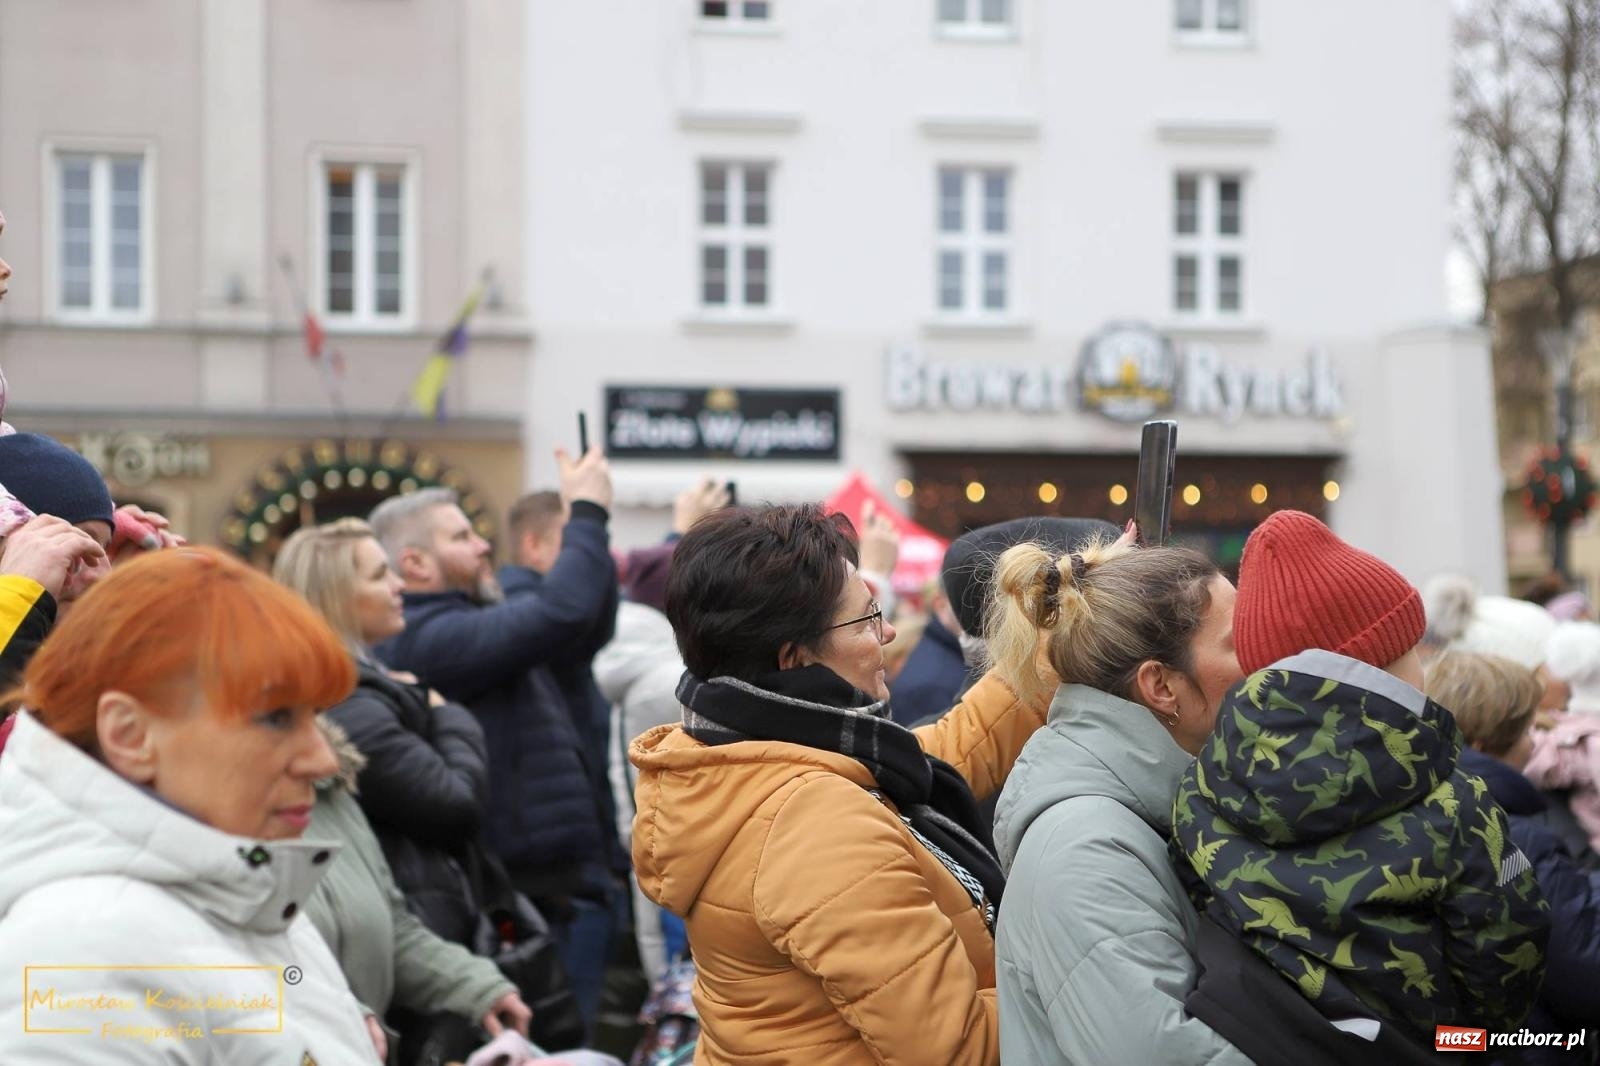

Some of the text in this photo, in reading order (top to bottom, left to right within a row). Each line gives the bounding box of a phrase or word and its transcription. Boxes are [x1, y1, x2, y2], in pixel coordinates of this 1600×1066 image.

[887, 343, 1343, 423] Browar Rynek
[700, 409, 833, 456] Wypieki
